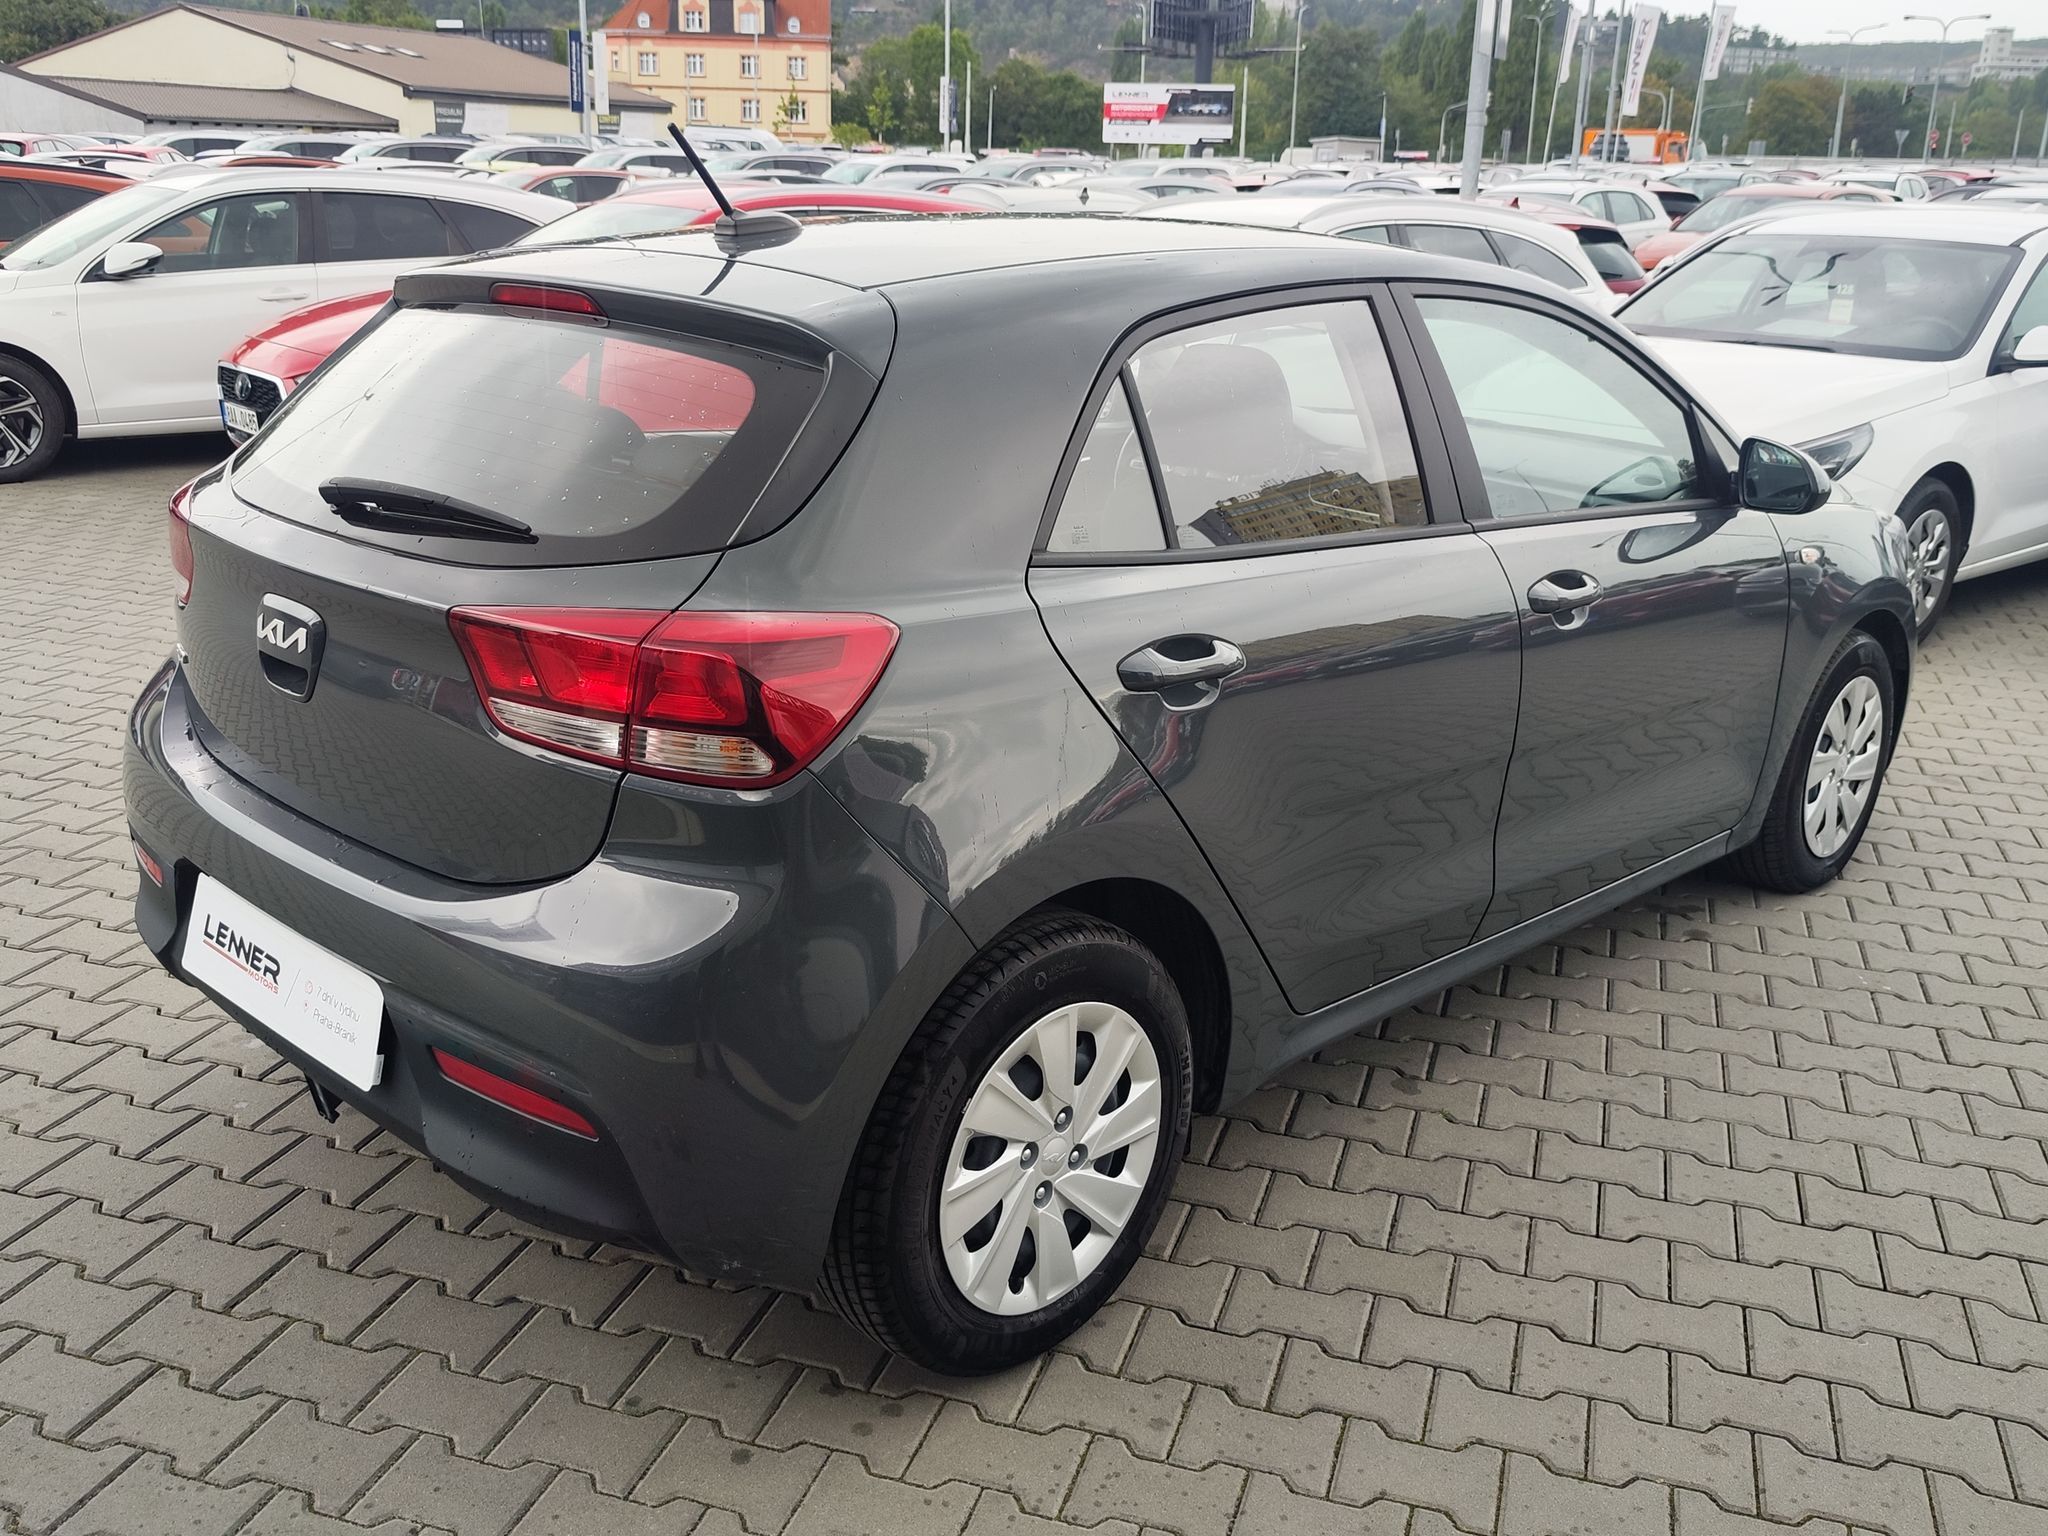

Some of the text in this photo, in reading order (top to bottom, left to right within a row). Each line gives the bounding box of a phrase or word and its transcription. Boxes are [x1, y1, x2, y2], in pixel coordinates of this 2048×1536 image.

[256, 612, 308, 655] KIA
[204, 913, 281, 986] LENNER
[248, 969, 280, 994] MOTORS
[316, 986, 361, 1023] 7 dní v týdnu
[312, 1008, 358, 1047] Praha-Braník
